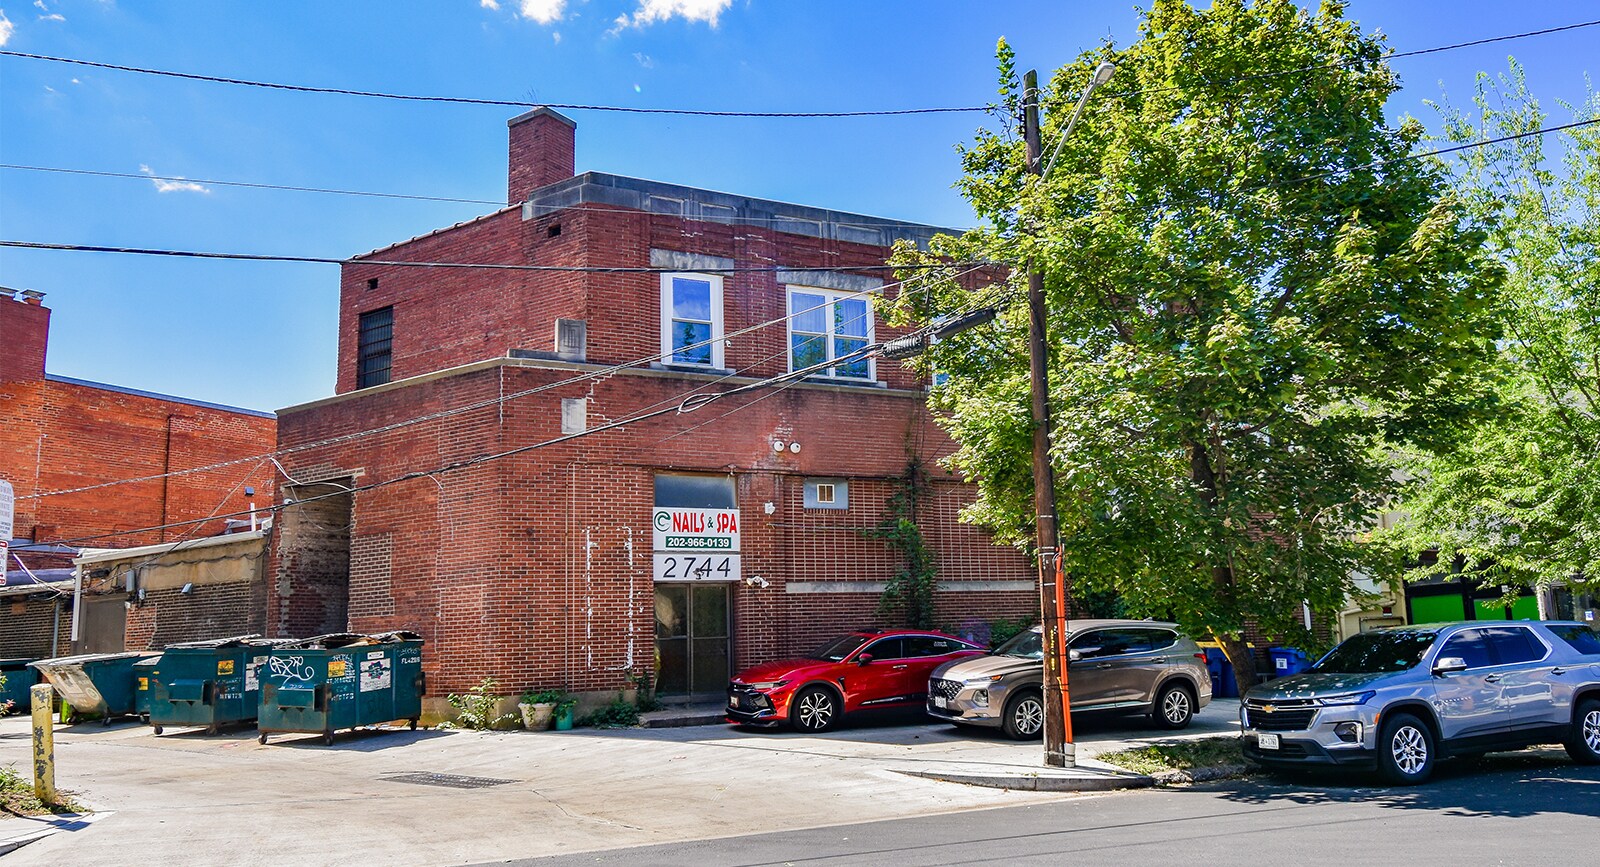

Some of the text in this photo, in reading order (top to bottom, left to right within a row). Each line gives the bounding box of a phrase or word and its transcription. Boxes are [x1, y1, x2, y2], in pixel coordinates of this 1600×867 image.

[672, 512, 705, 533] NAILS
[707, 516, 714, 529] &
[716, 512, 738, 534] SPA
[667, 537, 730, 547] 202-966-0139
[663, 557, 731, 578] 2744
